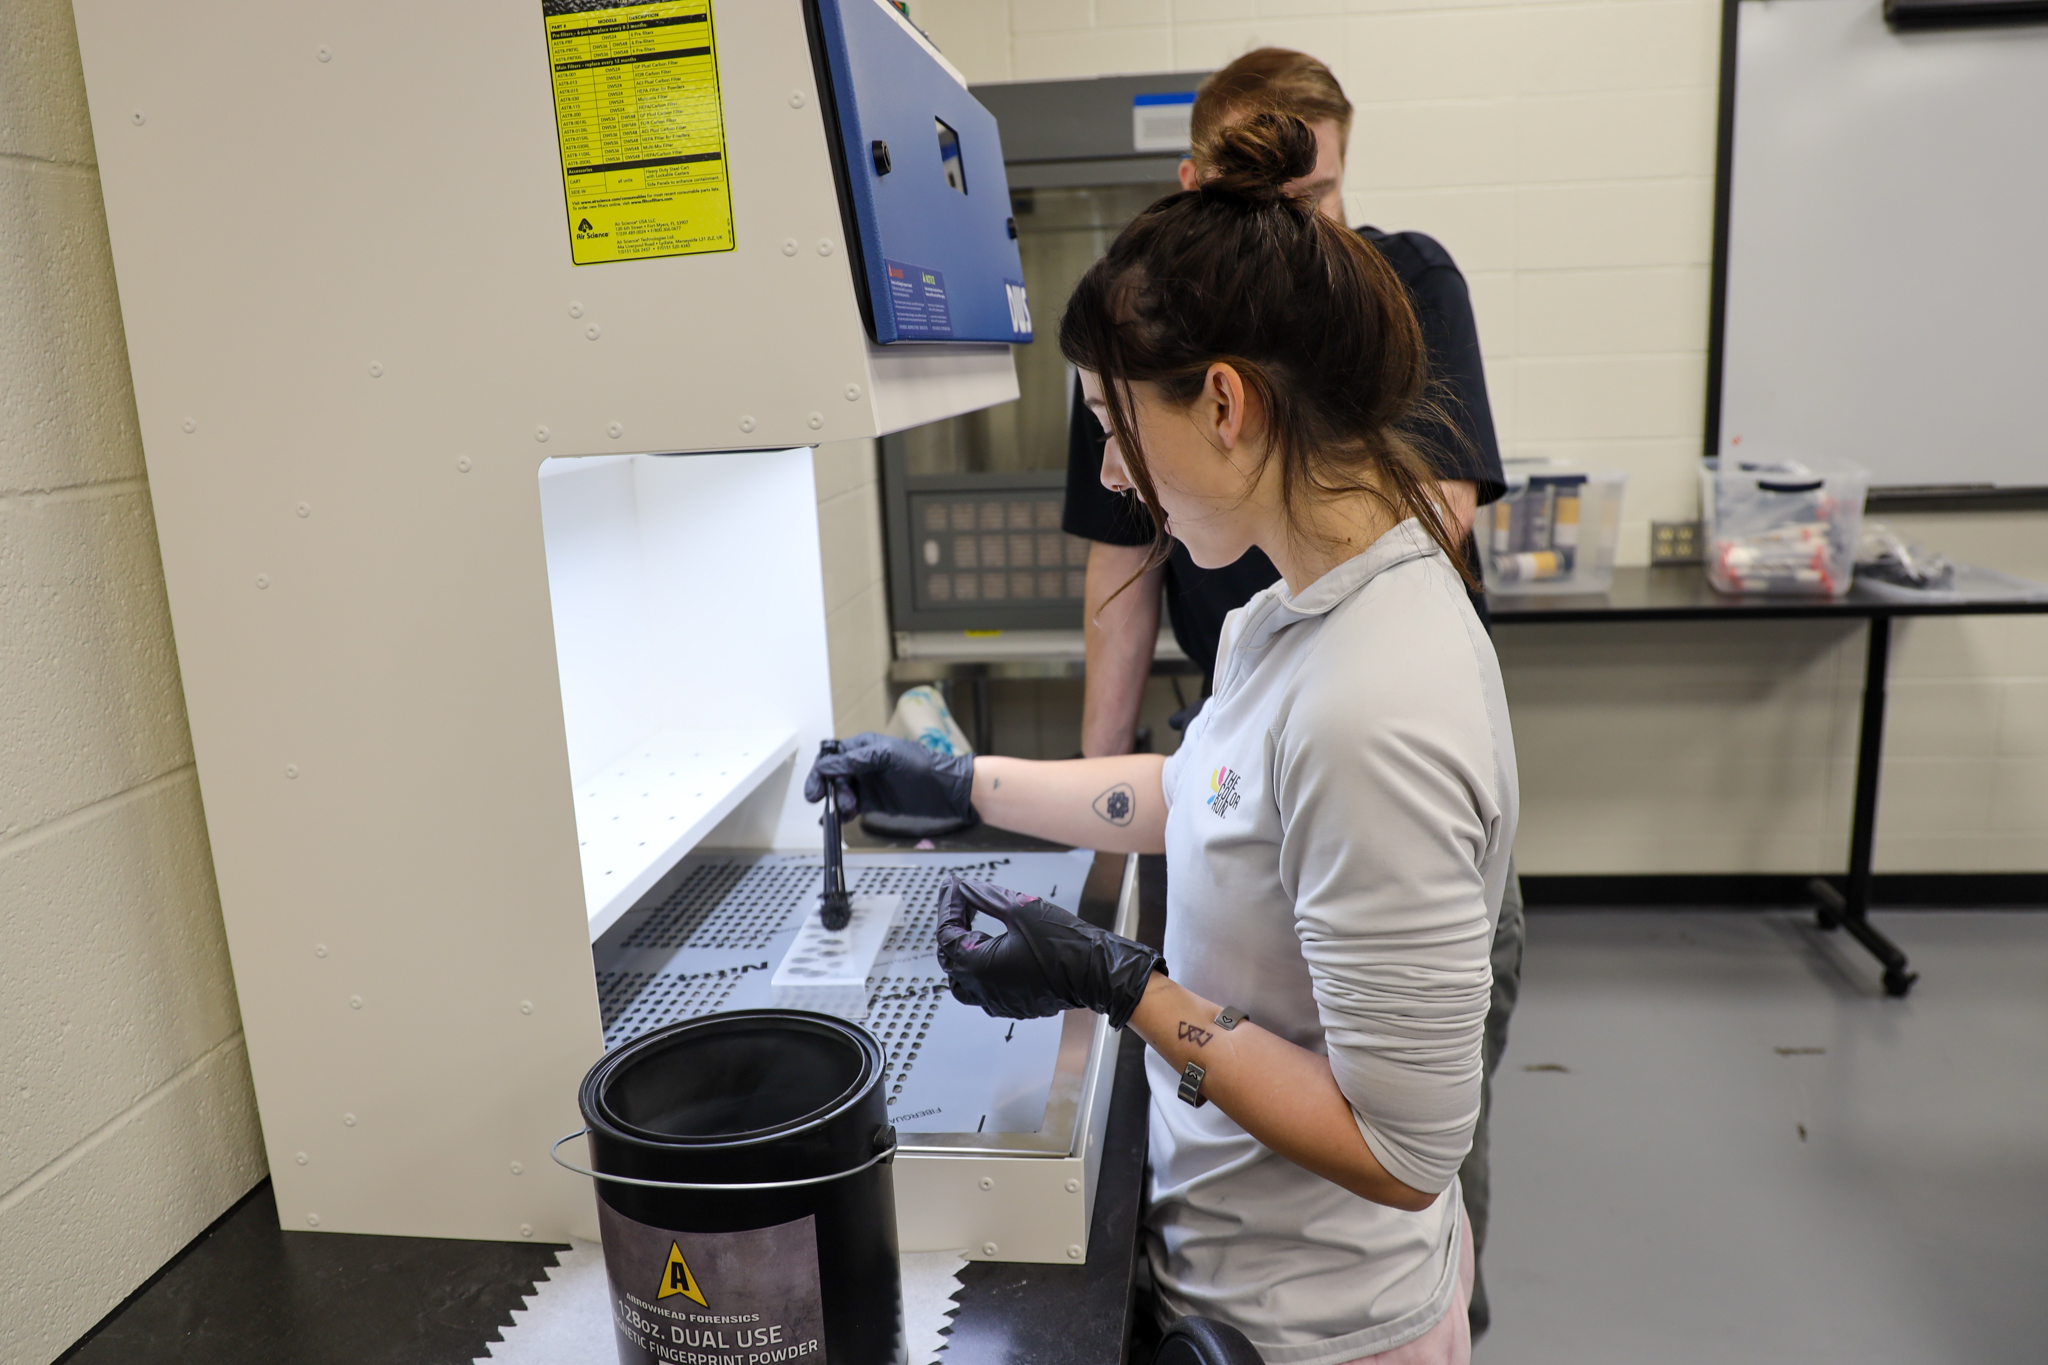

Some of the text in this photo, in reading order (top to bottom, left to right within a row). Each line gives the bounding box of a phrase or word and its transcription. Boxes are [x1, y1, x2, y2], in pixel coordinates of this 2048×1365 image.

[629, 12, 659, 20] DESCRIPTION
[1224, 769, 1241, 790] THE
[1218, 783, 1241, 810] COLOR
[670, 1262, 690, 1291] A
[626, 1292, 760, 1324] ARROWHEAD FORENSICS
[618, 1300, 782, 1349] 128oz. DUAL USE
[649, 1341, 744, 1365] FINGERPRINT
[750, 1339, 818, 1365] POWDER
